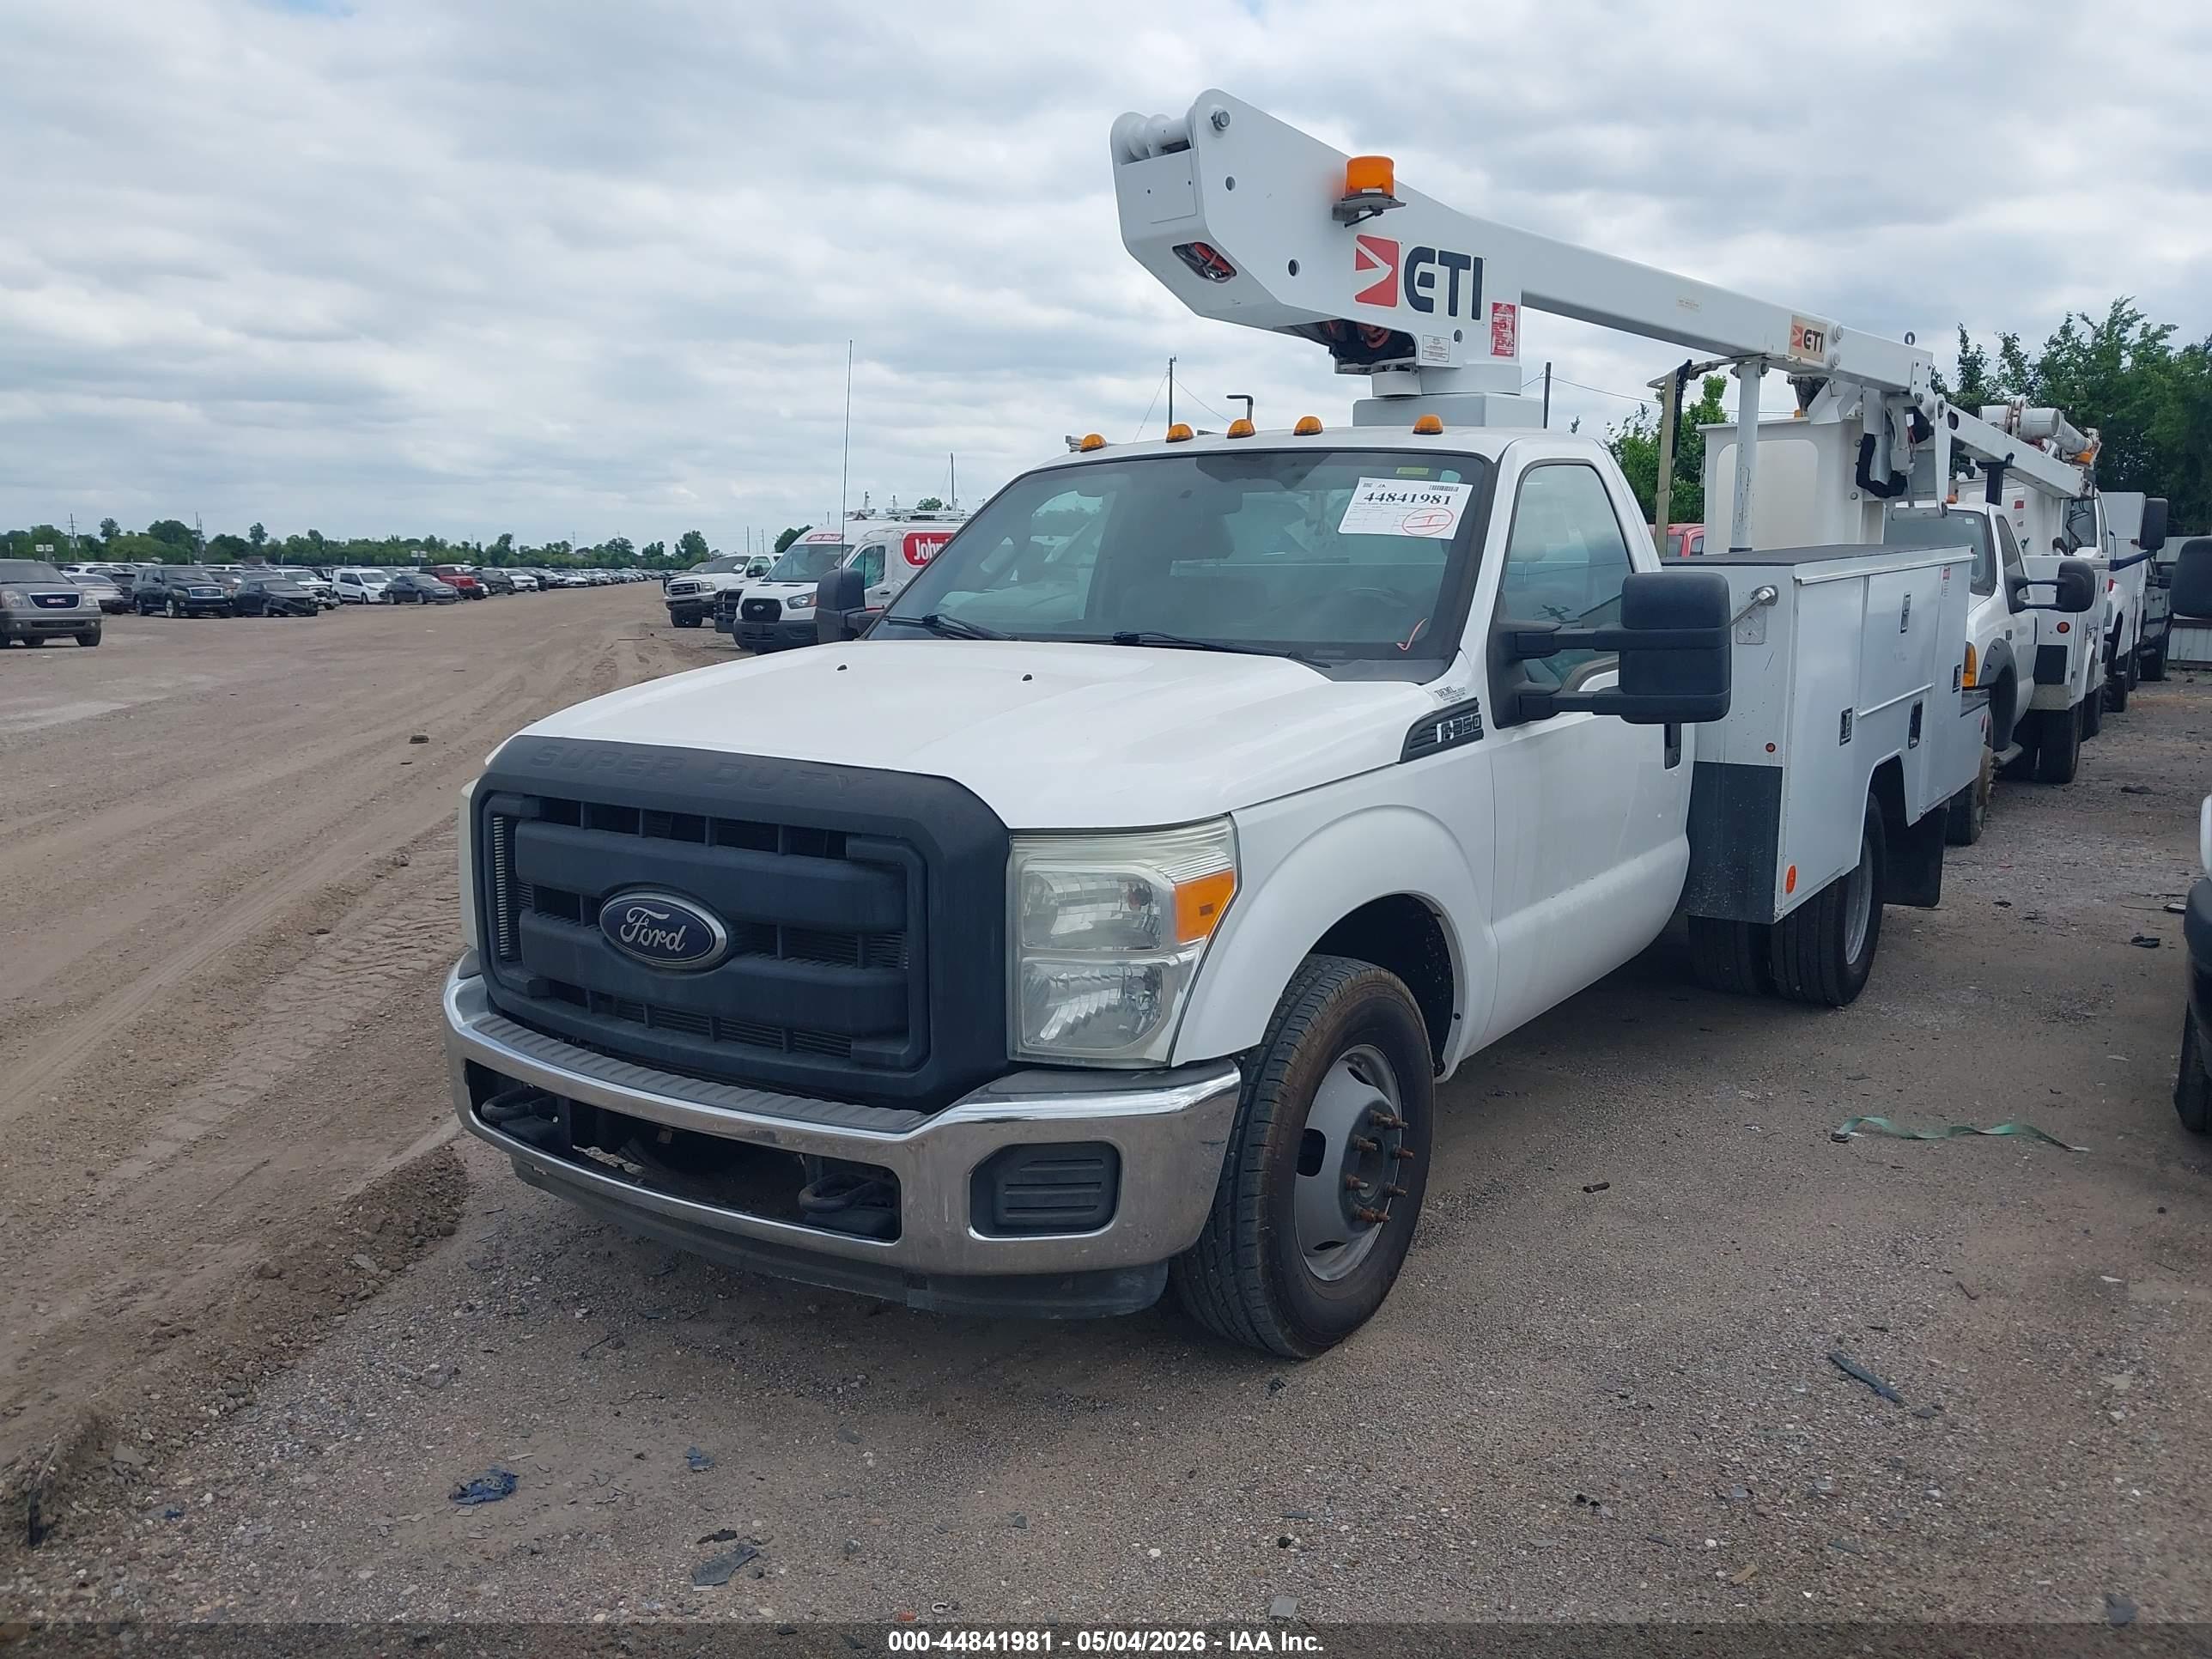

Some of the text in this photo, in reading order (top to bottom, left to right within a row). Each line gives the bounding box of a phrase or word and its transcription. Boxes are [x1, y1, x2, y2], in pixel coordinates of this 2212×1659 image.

[1404, 246, 1483, 320] ETI
[1803, 329, 1824, 353] ETI
[1364, 492, 1451, 506] 44841981
[530, 744, 872, 797] SUPER DUTY
[620, 907, 688, 951] Ford
